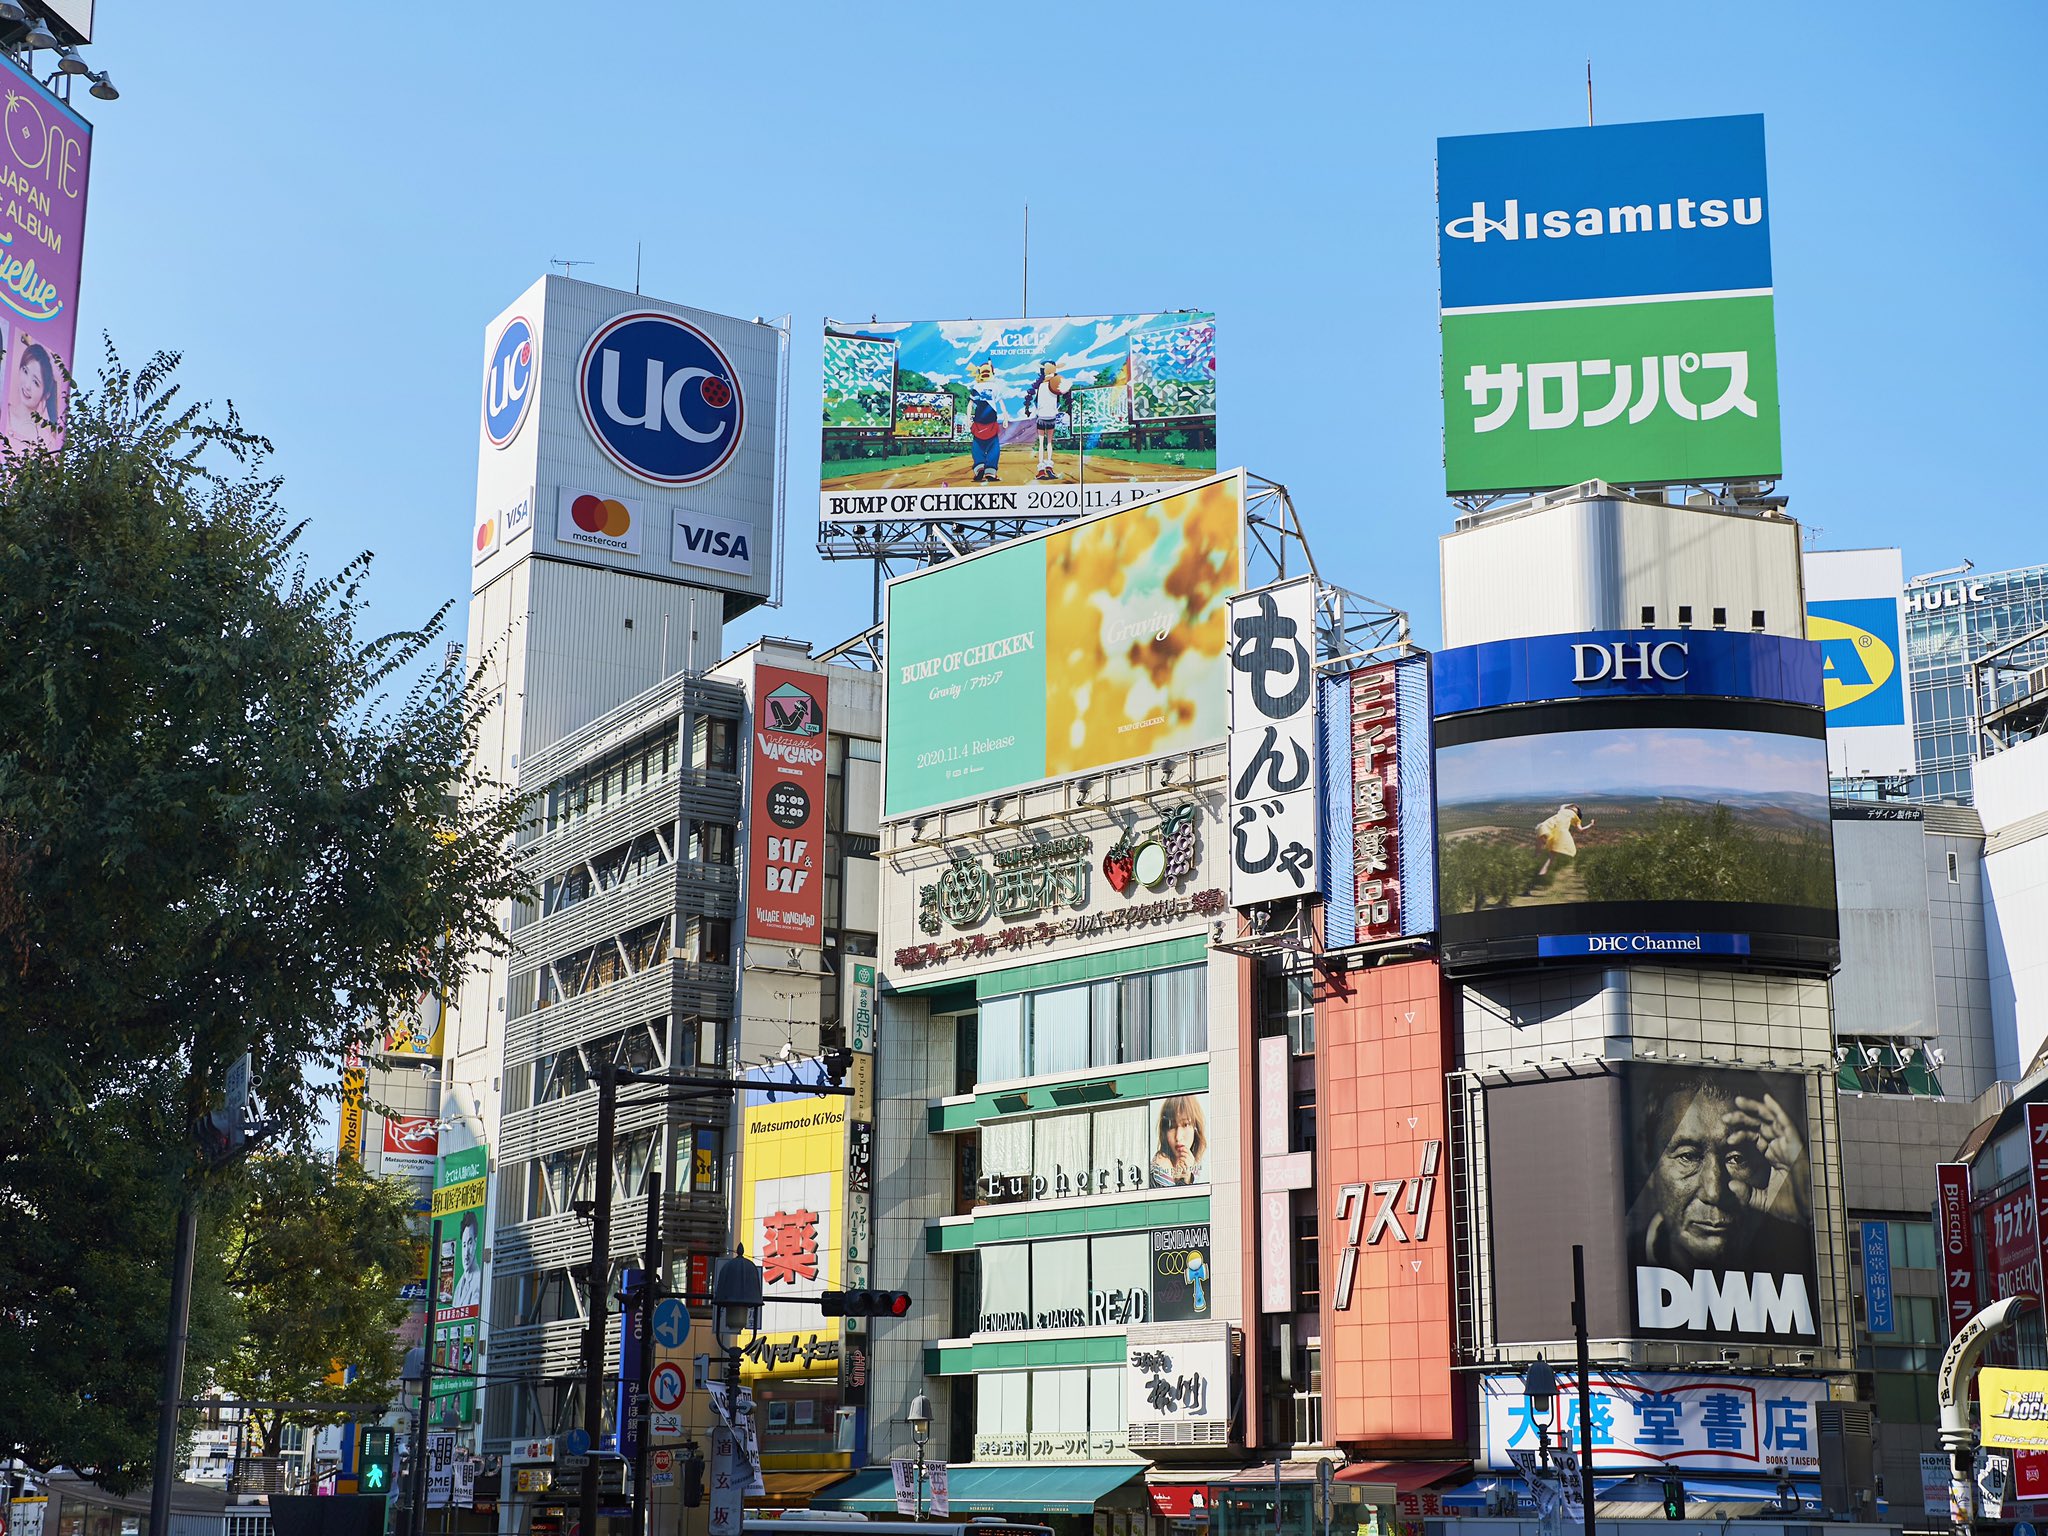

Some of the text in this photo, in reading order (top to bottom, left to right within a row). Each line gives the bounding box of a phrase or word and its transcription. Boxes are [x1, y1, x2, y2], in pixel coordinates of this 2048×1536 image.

[6, 200, 62, 254] ALBUM
[1445, 197, 1763, 243] Hisamitsu
[1464, 351, 1758, 433] サロンパス
[506, 499, 528, 529] VISA
[829, 495, 888, 515] BUMP
[889, 495, 917, 514] OF
[918, 491, 1018, 513] CHICKEN
[1027, 489, 1123, 510] 2020.11.4
[572, 531, 627, 549] mastercard
[677, 523, 750, 561] VISA
[1904, 583, 1992, 614] HULIC
[901, 631, 1035, 685] BUMP OF CHICKEN
[1571, 641, 1689, 684] DHC
[929, 682, 962, 702] Gravity
[970, 671, 1004, 692] アカシア
[917, 733, 1016, 769] 2020.11.4 Release
[1232, 591, 1314, 889] もんじゃ
[1350, 672, 1391, 928] 三千里薬品
[1866, 809, 1921, 820] デザイン製作中
[768, 836, 808, 864] B1F
[804, 856, 813, 868] &
[766, 866, 809, 894] B2F
[991, 856, 1085, 918] 西村
[1588, 934, 1701, 952] DHC Channel
[750, 1117, 811, 1134] Matsumoto
[384, 1156, 418, 1164] Matsumoto
[986, 1158, 1142, 1202] Euphoria
[762, 1208, 820, 1286] 薬
[1154, 1227, 1210, 1251] DENDAMA
[1868, 1227, 1890, 1327] 大盛堂商事ビル
[1635, 1265, 1816, 1336] DMM
[979, 1308, 1081, 1333] DENDAMA & DARTS
[1940, 1323, 1978, 1402] 渋谷センター街
[627, 1381, 640, 1443] みずほ銀行
[1765, 1456, 1788, 1465] BOOKS
[428, 1476, 450, 1487] OME
[713, 1439, 733, 1526] 道玄坂
